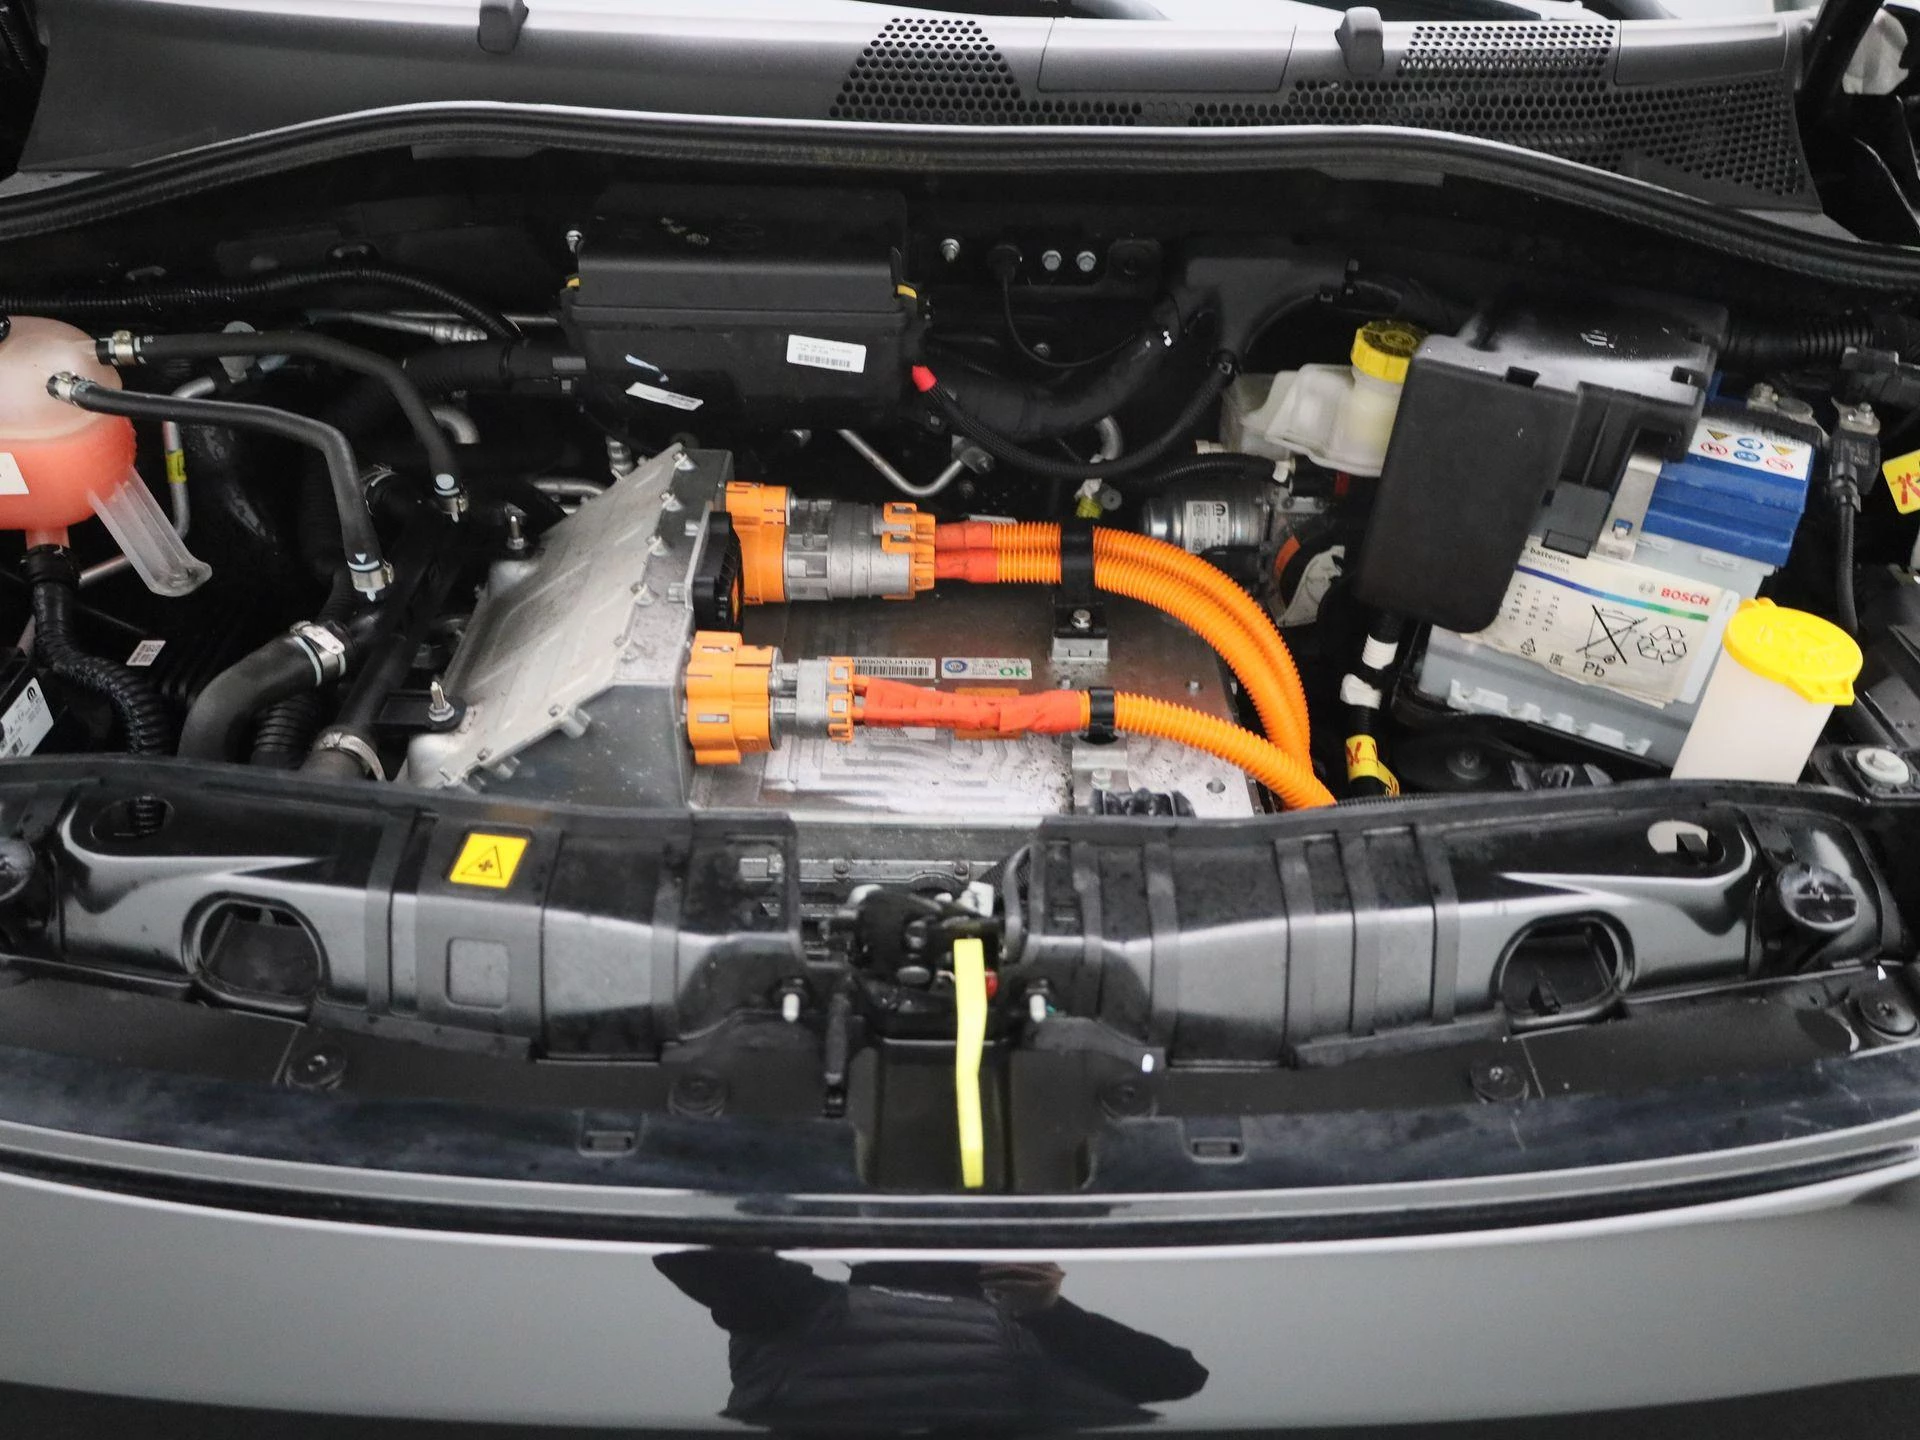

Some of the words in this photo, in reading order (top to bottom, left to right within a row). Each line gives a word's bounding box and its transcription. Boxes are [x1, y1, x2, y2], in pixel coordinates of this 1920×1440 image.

[1660, 586, 1710, 606] BOSCH
[999, 666, 1028, 677] OK
[1582, 660, 1605, 678] Pb
